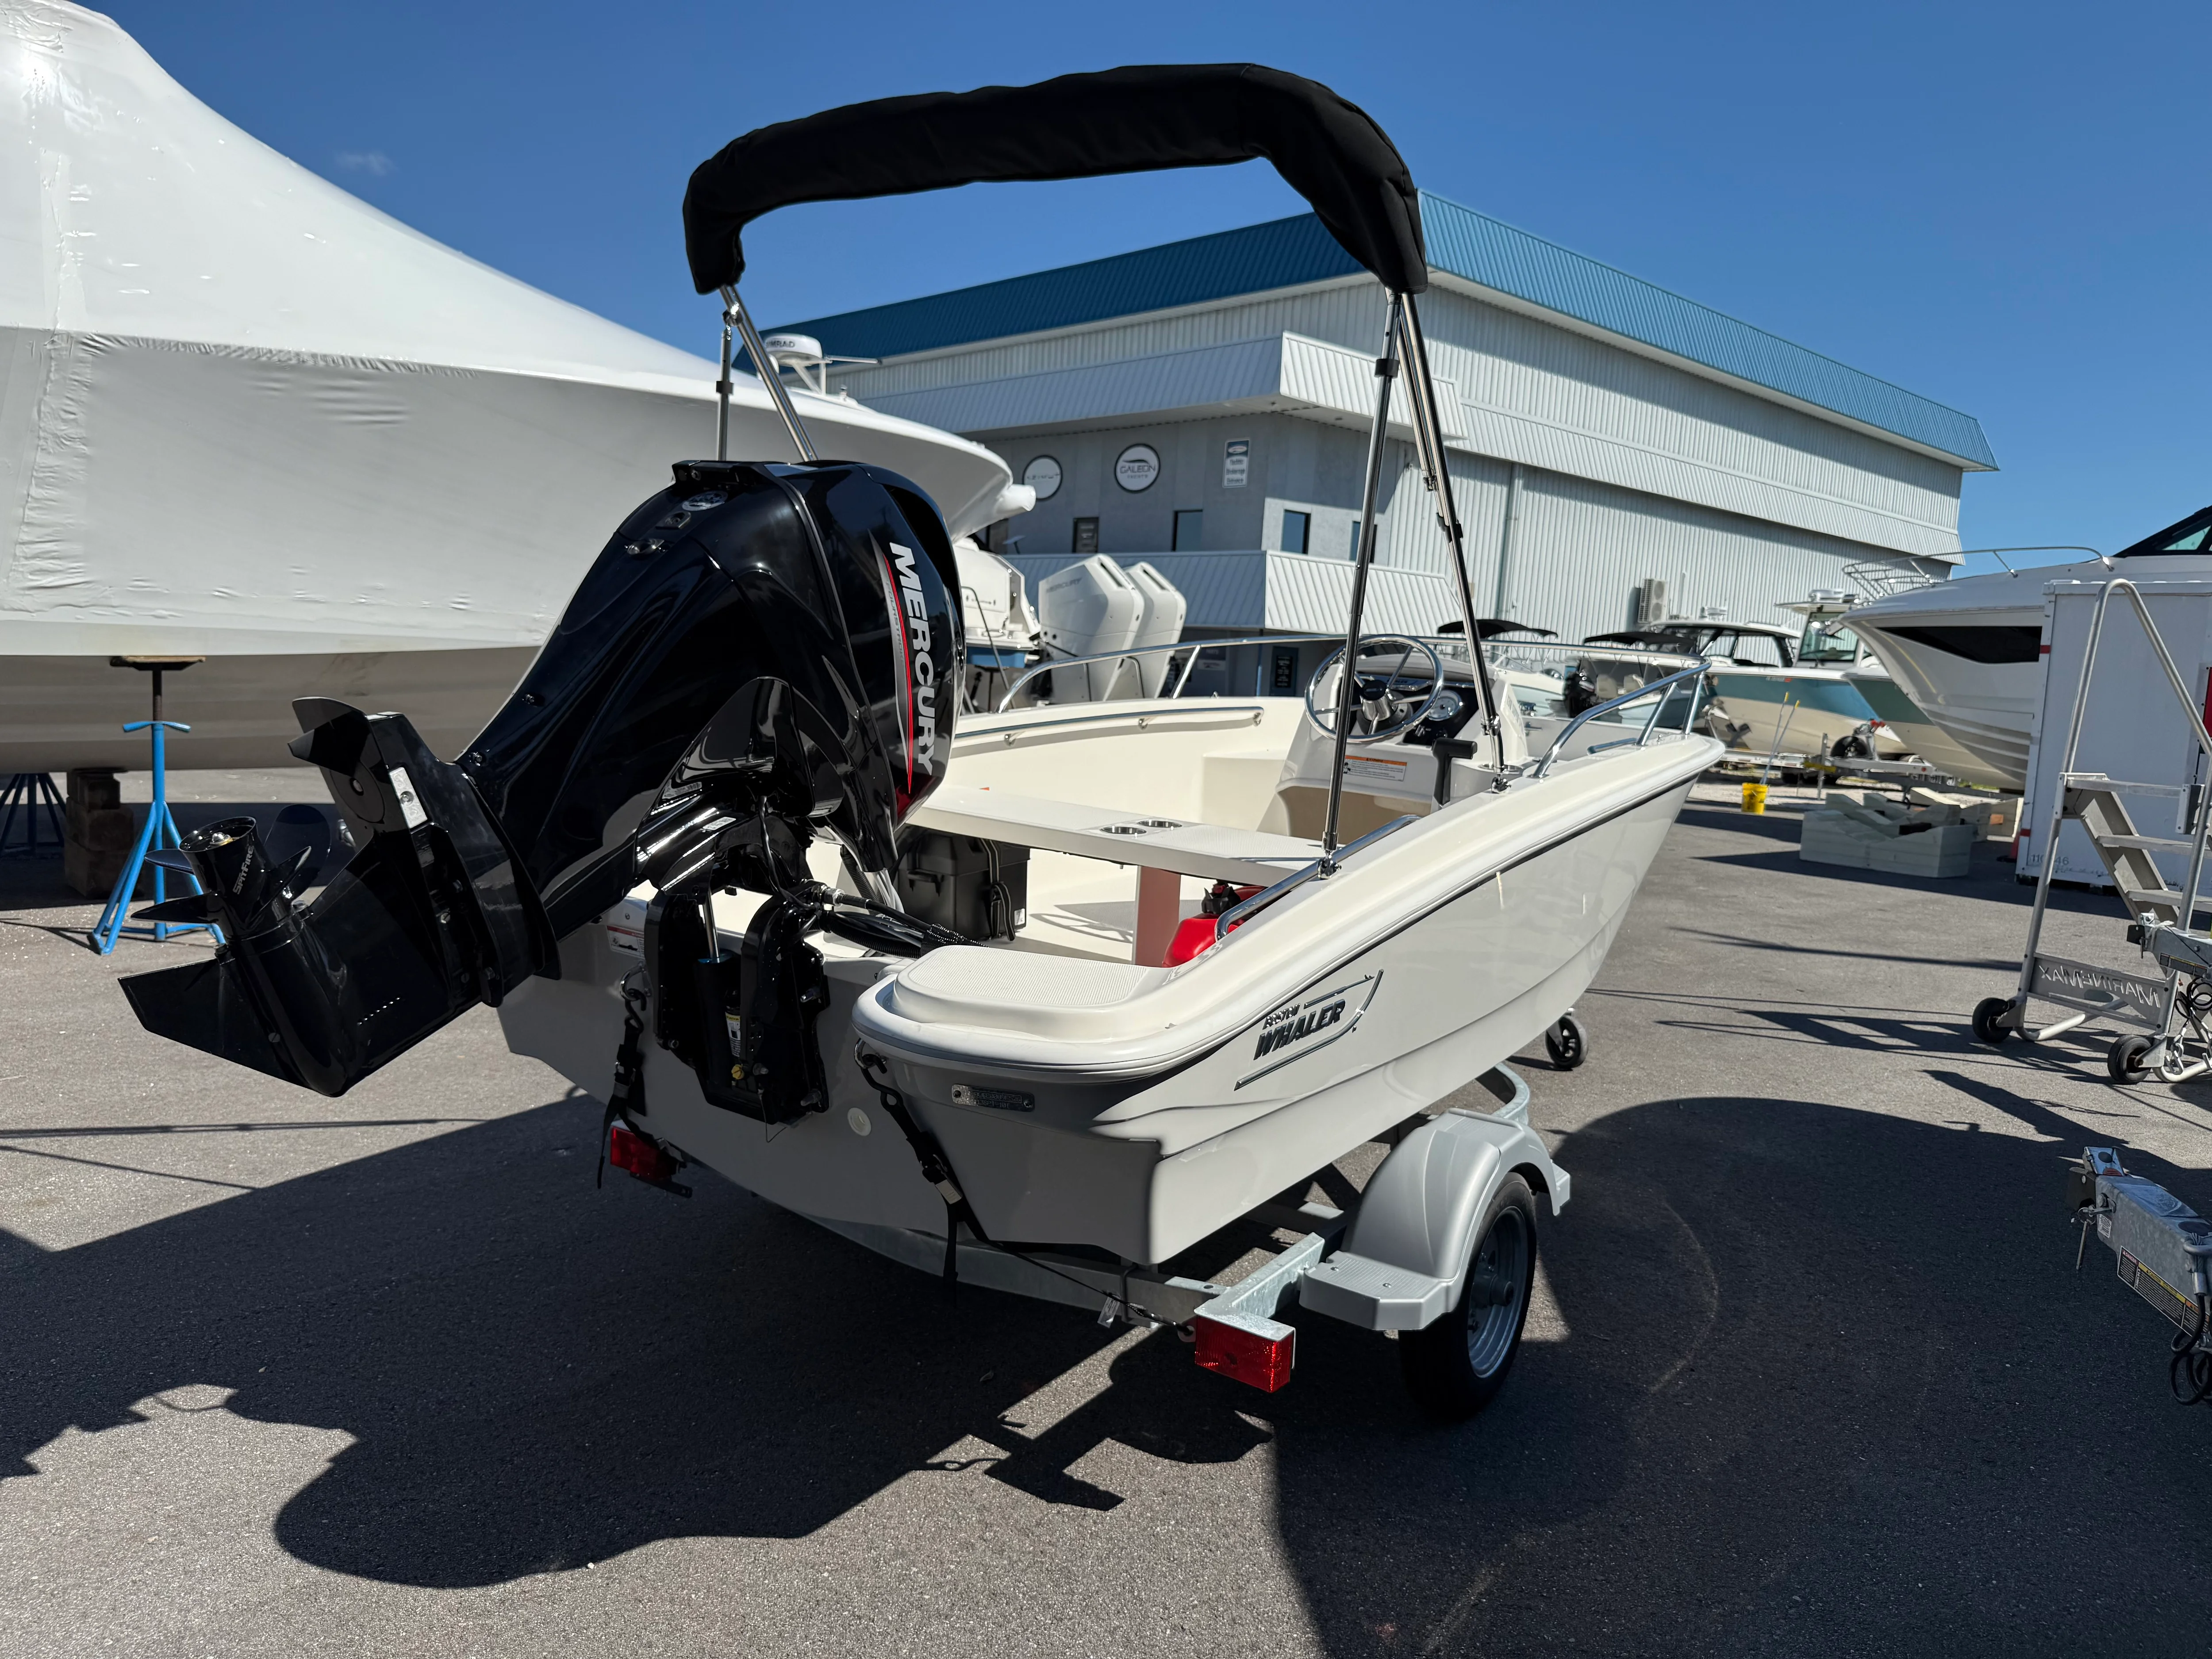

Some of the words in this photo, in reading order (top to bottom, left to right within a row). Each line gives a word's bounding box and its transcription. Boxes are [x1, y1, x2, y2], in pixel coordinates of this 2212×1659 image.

[1119, 464, 1156, 474] GALEON
[889, 542, 936, 776] MERCURY
[1253, 998, 1345, 1060] WHALER
